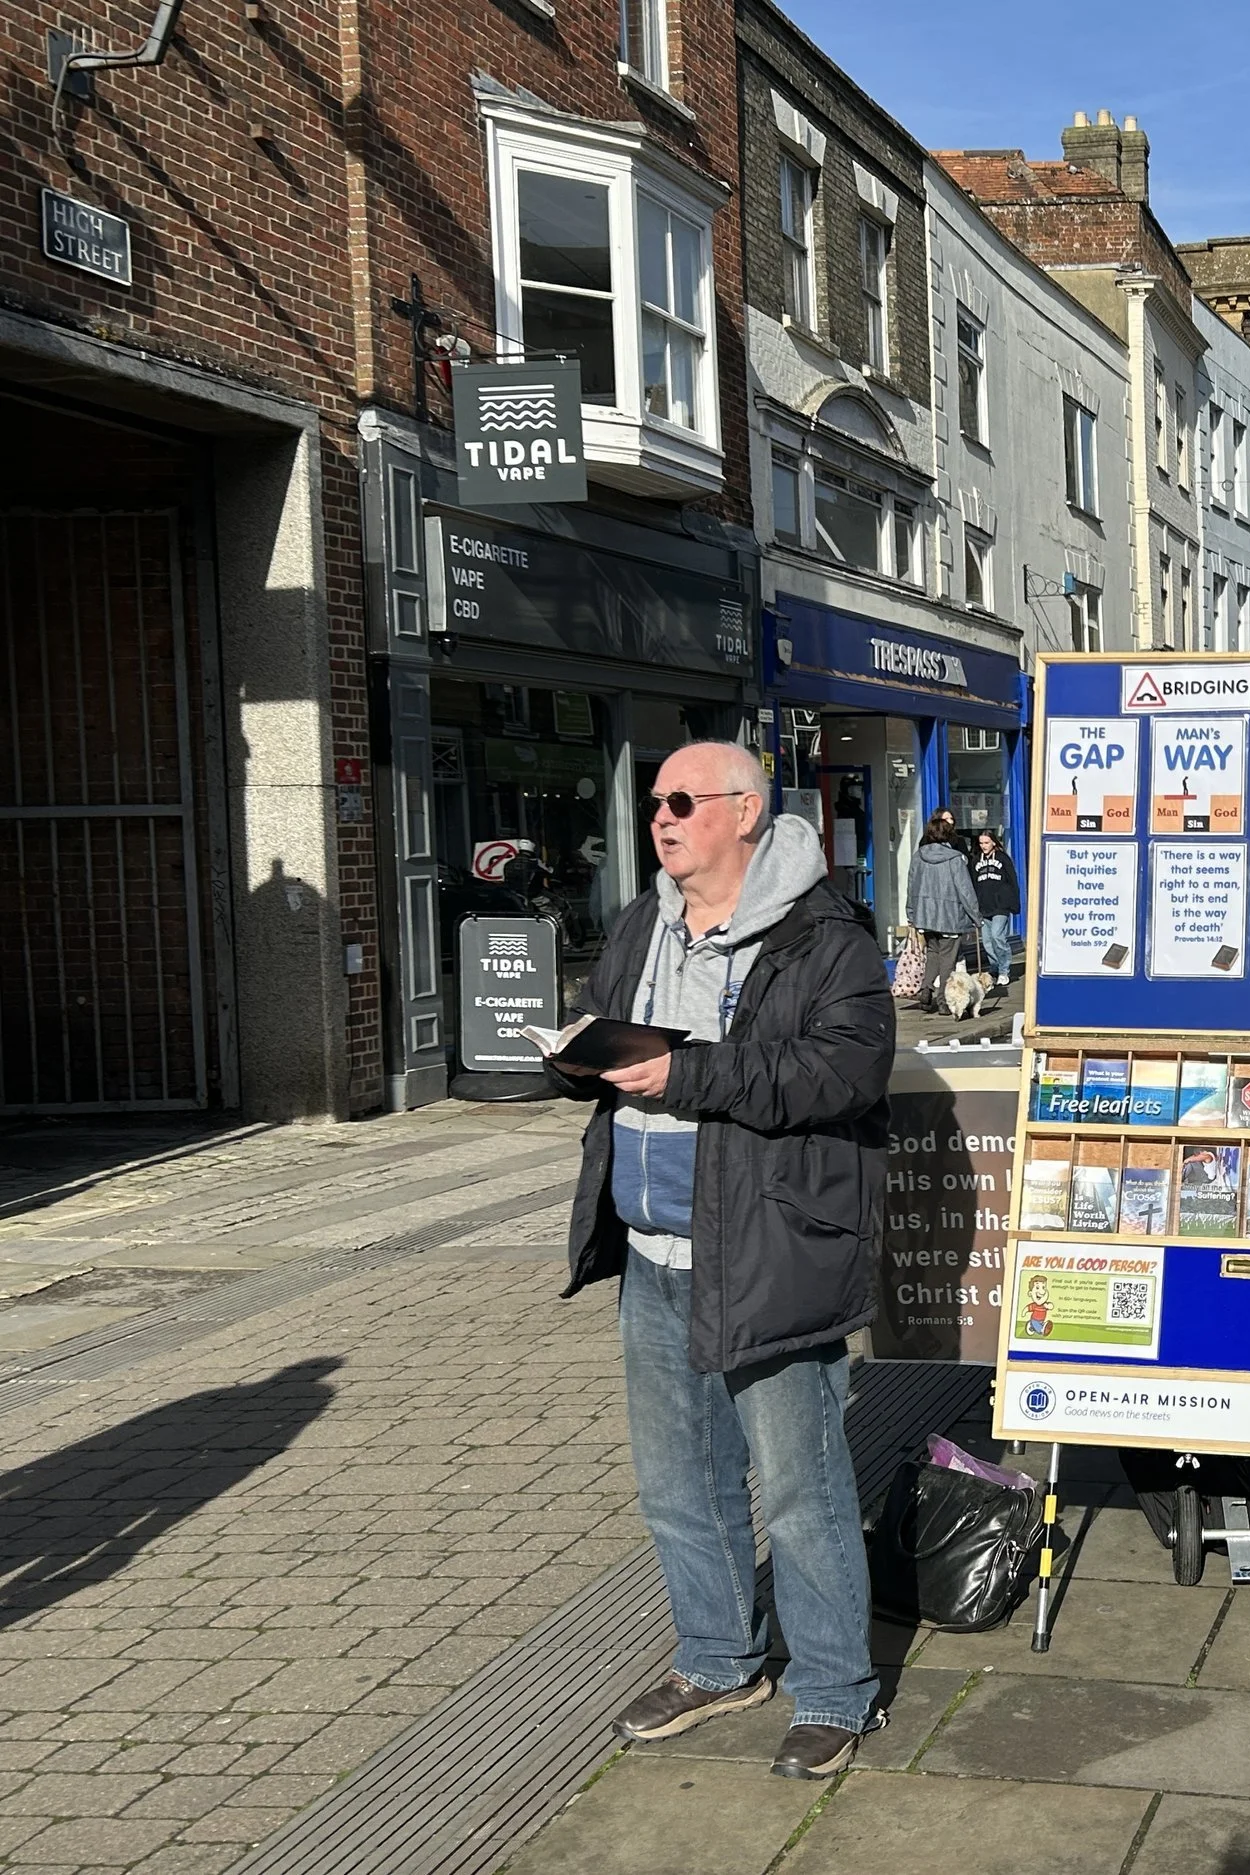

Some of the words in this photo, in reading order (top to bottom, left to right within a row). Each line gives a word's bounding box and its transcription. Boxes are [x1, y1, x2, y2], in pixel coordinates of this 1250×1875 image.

[52, 201, 103, 239] HIGH
[54, 231, 122, 273] STREET
[464, 439, 576, 466] TIDAL
[497, 466, 546, 481] VAPE
[450, 534, 529, 569] E-CIGARETTE
[452, 566, 485, 589] VAPE
[453, 598, 480, 620] CBD
[716, 634, 748, 656] TIDAL
[725, 655, 740, 664] VAPE
[870, 637, 940, 680] TRESPASS
[1163, 680, 1248, 695] BRIDGING
[1080, 727, 1105, 739] THE
[1176, 728, 1220, 740] MAN's
[1060, 743, 1124, 769] GAP
[1164, 744, 1233, 771] WAY
[1051, 808, 1071, 816] Man
[1107, 808, 1130, 817] God
[1080, 819, 1096, 828] Sin
[1092, 852, 1117, 861] your
[1161, 851, 1192, 860] 'There
[1197, 851, 1206, 860] is
[1220, 852, 1241, 862] way
[1066, 865, 1117, 876] iniquities
[1171, 865, 1192, 875] that
[1196, 867, 1229, 875] seems
[1078, 880, 1104, 890] have
[1160, 880, 1185, 891] right
[1189, 880, 1199, 889] to
[1214, 881, 1240, 891] man,
[1062, 896, 1119, 907] separated
[1171, 894, 1189, 904] but
[1192, 895, 1204, 904] its
[1208, 894, 1228, 904] end
[1064, 912, 1086, 922] you
[1089, 911, 1115, 922] from
[1172, 909, 1180, 917] is
[1184, 908, 1201, 917] the
[1205, 910, 1226, 920] way
[1062, 927, 1086, 938] your
[1092, 926, 1117, 937] God'
[1175, 922, 1186, 932] of
[1189, 922, 1223, 932] death'
[480, 959, 536, 972] TIDAL
[475, 997, 543, 1008] E-CIGARETTE
[495, 1013, 523, 1023] VAPE
[497, 1027, 521, 1037] CBD
[1049, 1095, 1089, 1113] Free
[1094, 1095, 1161, 1116] leaflets
[887, 1130, 936, 1154] God
[887, 1170, 931, 1193] His
[943, 1173, 995, 1192] own
[1124, 1191, 1161, 1200] Cross?
[1197, 1191, 1235, 1200] Suffering?
[890, 1213, 930, 1233] us,
[941, 1207, 964, 1229] in
[1073, 1221, 1108, 1229] Living?
[893, 1249, 958, 1267] were
[1022, 1256, 1042, 1268] ARE
[1045, 1256, 1065, 1268] YOU
[1067, 1256, 1074, 1269] A
[1077, 1258, 1107, 1270] GOOD
[1109, 1260, 1157, 1274] PERSON?
[897, 1283, 980, 1306] Christ
[908, 1316, 952, 1326] Romans
[957, 1316, 974, 1326] 5:8
[1066, 1390, 1149, 1405] OPEN-AIR
[1159, 1395, 1231, 1409] MISSION
[1064, 1406, 1088, 1416] Good
[1090, 1409, 1111, 1417] news
[1126, 1409, 1139, 1419] the
[1142, 1411, 1171, 1421] streets
